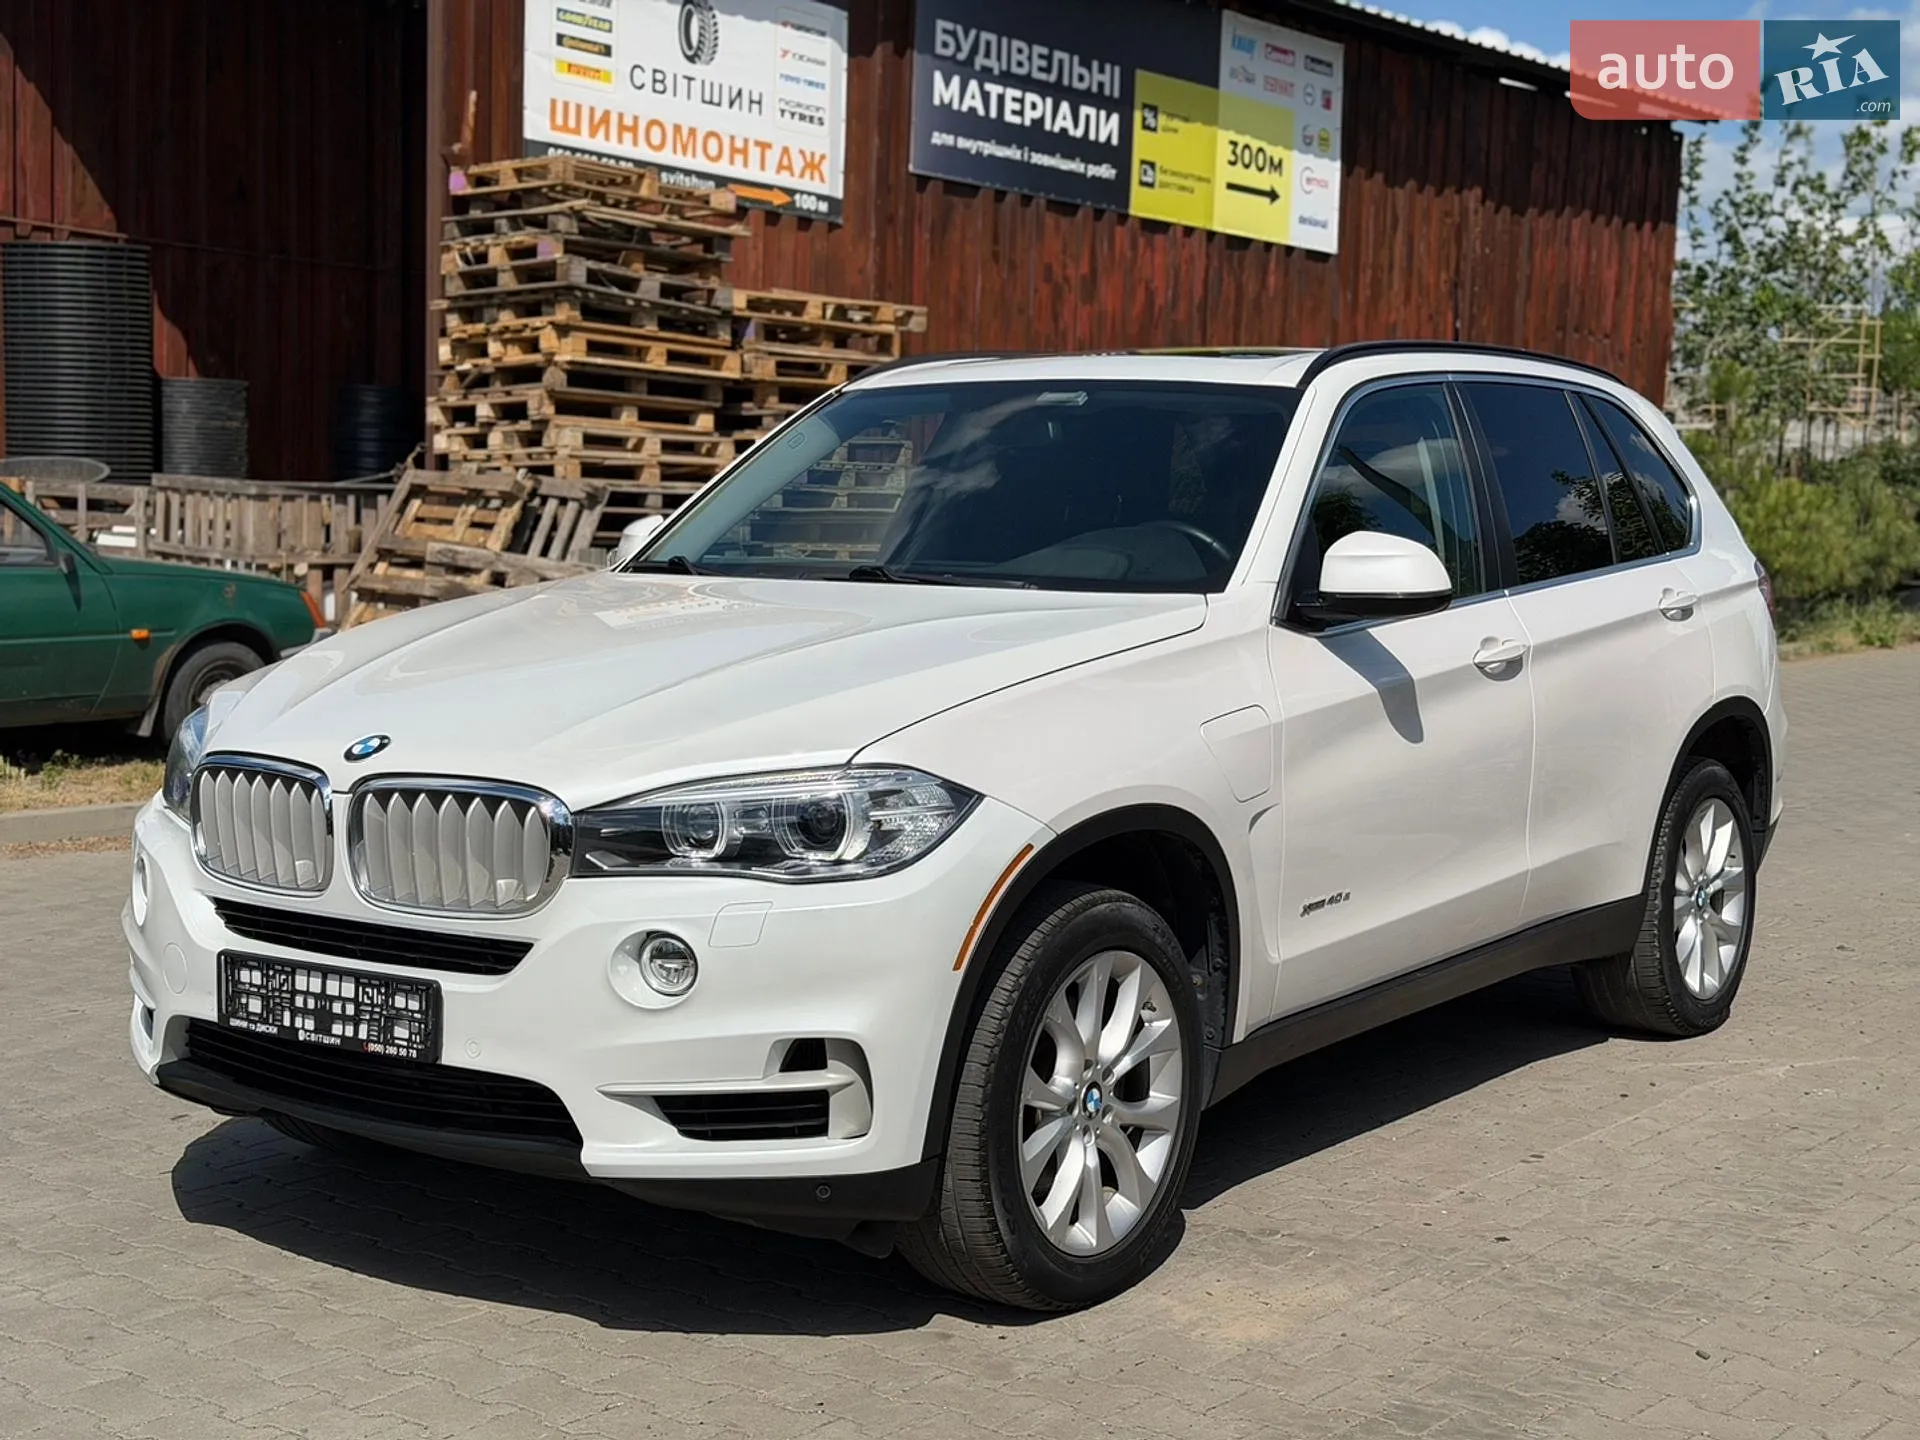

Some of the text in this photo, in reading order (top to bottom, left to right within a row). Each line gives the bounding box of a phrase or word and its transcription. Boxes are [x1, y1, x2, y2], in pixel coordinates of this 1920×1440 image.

[629, 63, 763, 116] СВІТШИН
[934, 18, 1121, 99] БУДІВЕЛЬНІ
[549, 97, 828, 184] ШИНОМОНТАЖ
[778, 107, 825, 127] TYRES
[932, 70, 1120, 146] МАТЕРІАЛИ
